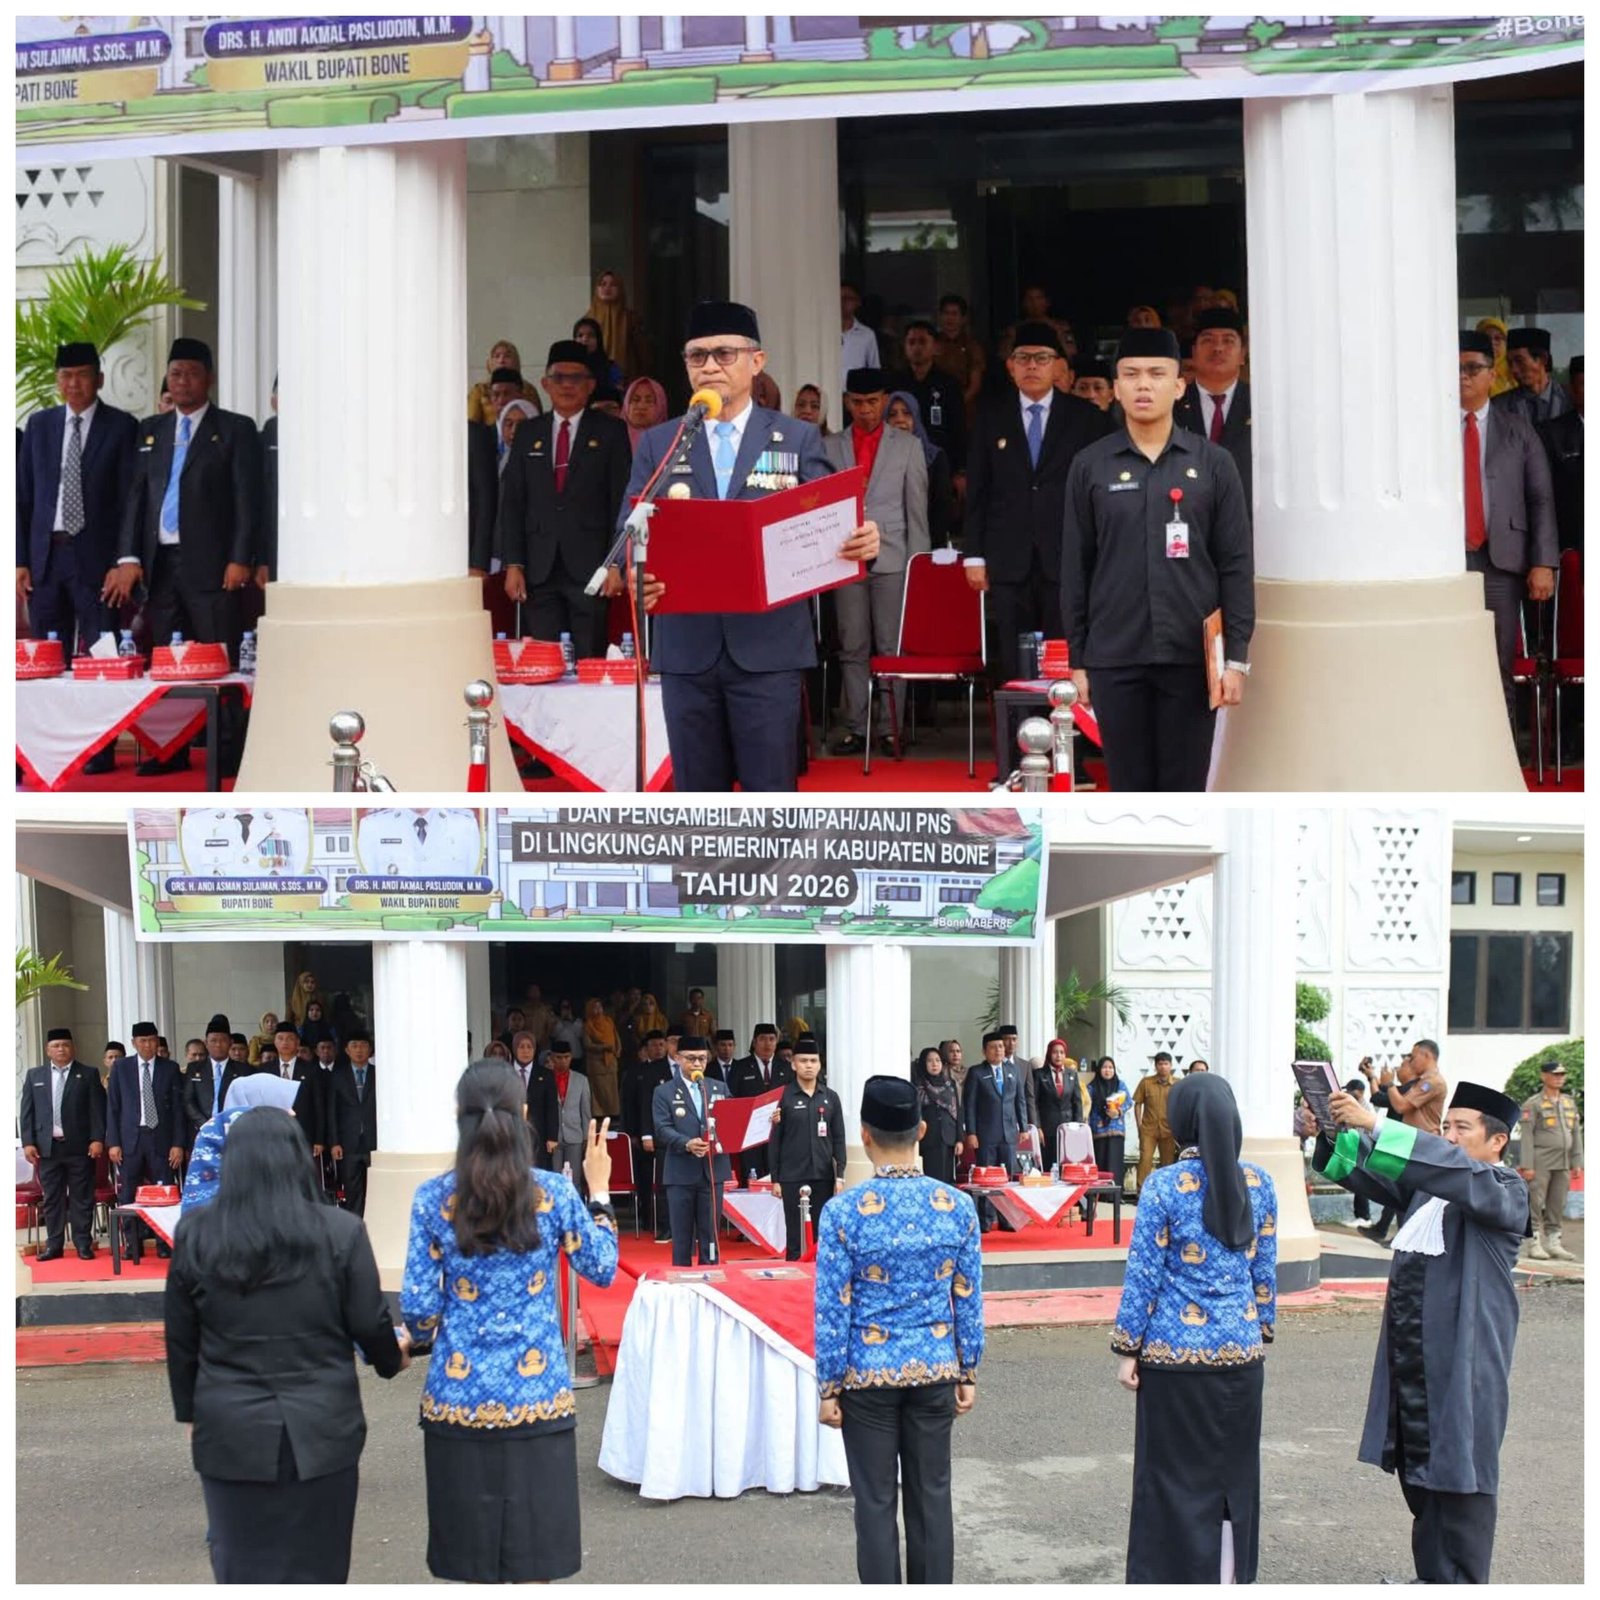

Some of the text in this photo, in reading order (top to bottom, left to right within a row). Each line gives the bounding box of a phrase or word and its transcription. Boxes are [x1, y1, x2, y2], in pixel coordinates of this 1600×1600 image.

[218, 16, 455, 50] DRS. H. ANDI AKMAL PASLUDDIN, M.M.
[30, 46, 90, 68] SULAIMAN,
[93, 42, 133, 62] S.SOS.,
[135, 39, 164, 58] M.M.
[264, 52, 410, 82] WAKIL BUPATI BONE
[44, 79, 79, 100] BONE
[568, 808, 951, 835] DAN PENGAMBILAN SUMPAH/JANJI PNS
[521, 831, 989, 866] DI LINGKUNGAN PEMERINTAH KABUPATEN BONE
[171, 881, 187, 891] DRS.
[188, 881, 195, 891] H.
[197, 881, 215, 891] ANDI
[216, 881, 241, 891] ASMAN
[242, 881, 280, 892] SULAIMAN,
[306, 881, 324, 891] M.M.
[355, 880, 485, 892] DRS. H. ANDI AKMAL PASLUDDIN, M.M.
[681, 872, 850, 898] TAHUN 2026
[221, 897, 274, 909] BUPATI BONE
[380, 897, 460, 909] WAKIL BUPATI BONE
